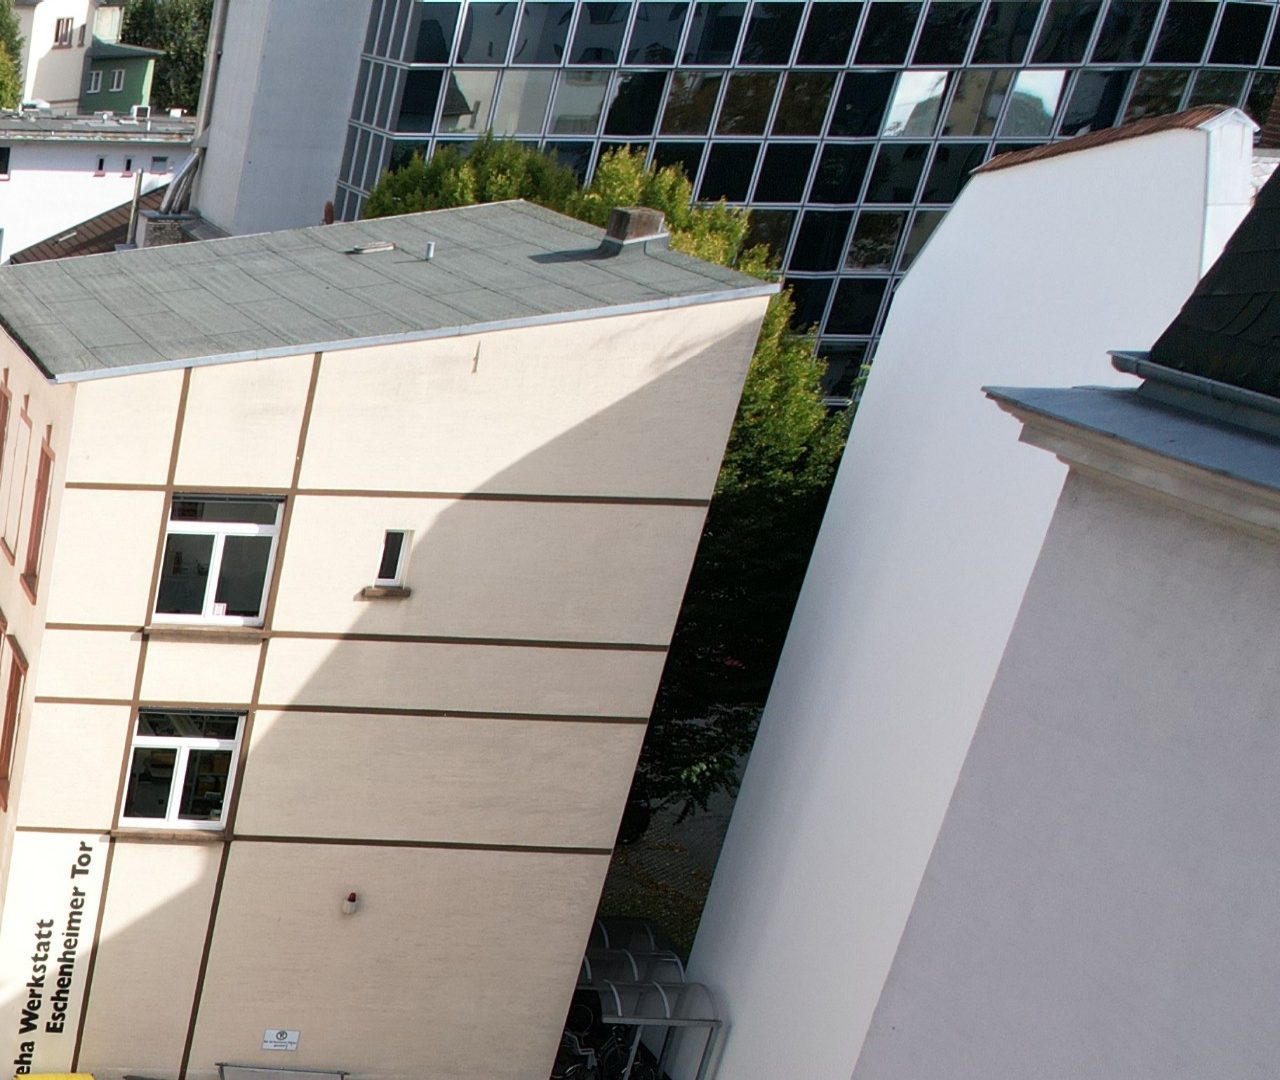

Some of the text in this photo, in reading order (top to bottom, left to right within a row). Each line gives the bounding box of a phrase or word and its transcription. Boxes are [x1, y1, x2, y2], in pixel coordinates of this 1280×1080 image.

[14, 918, 54, 1074] eha Werkstatt
[45, 840, 93, 1034] Eschenheimer Tor
